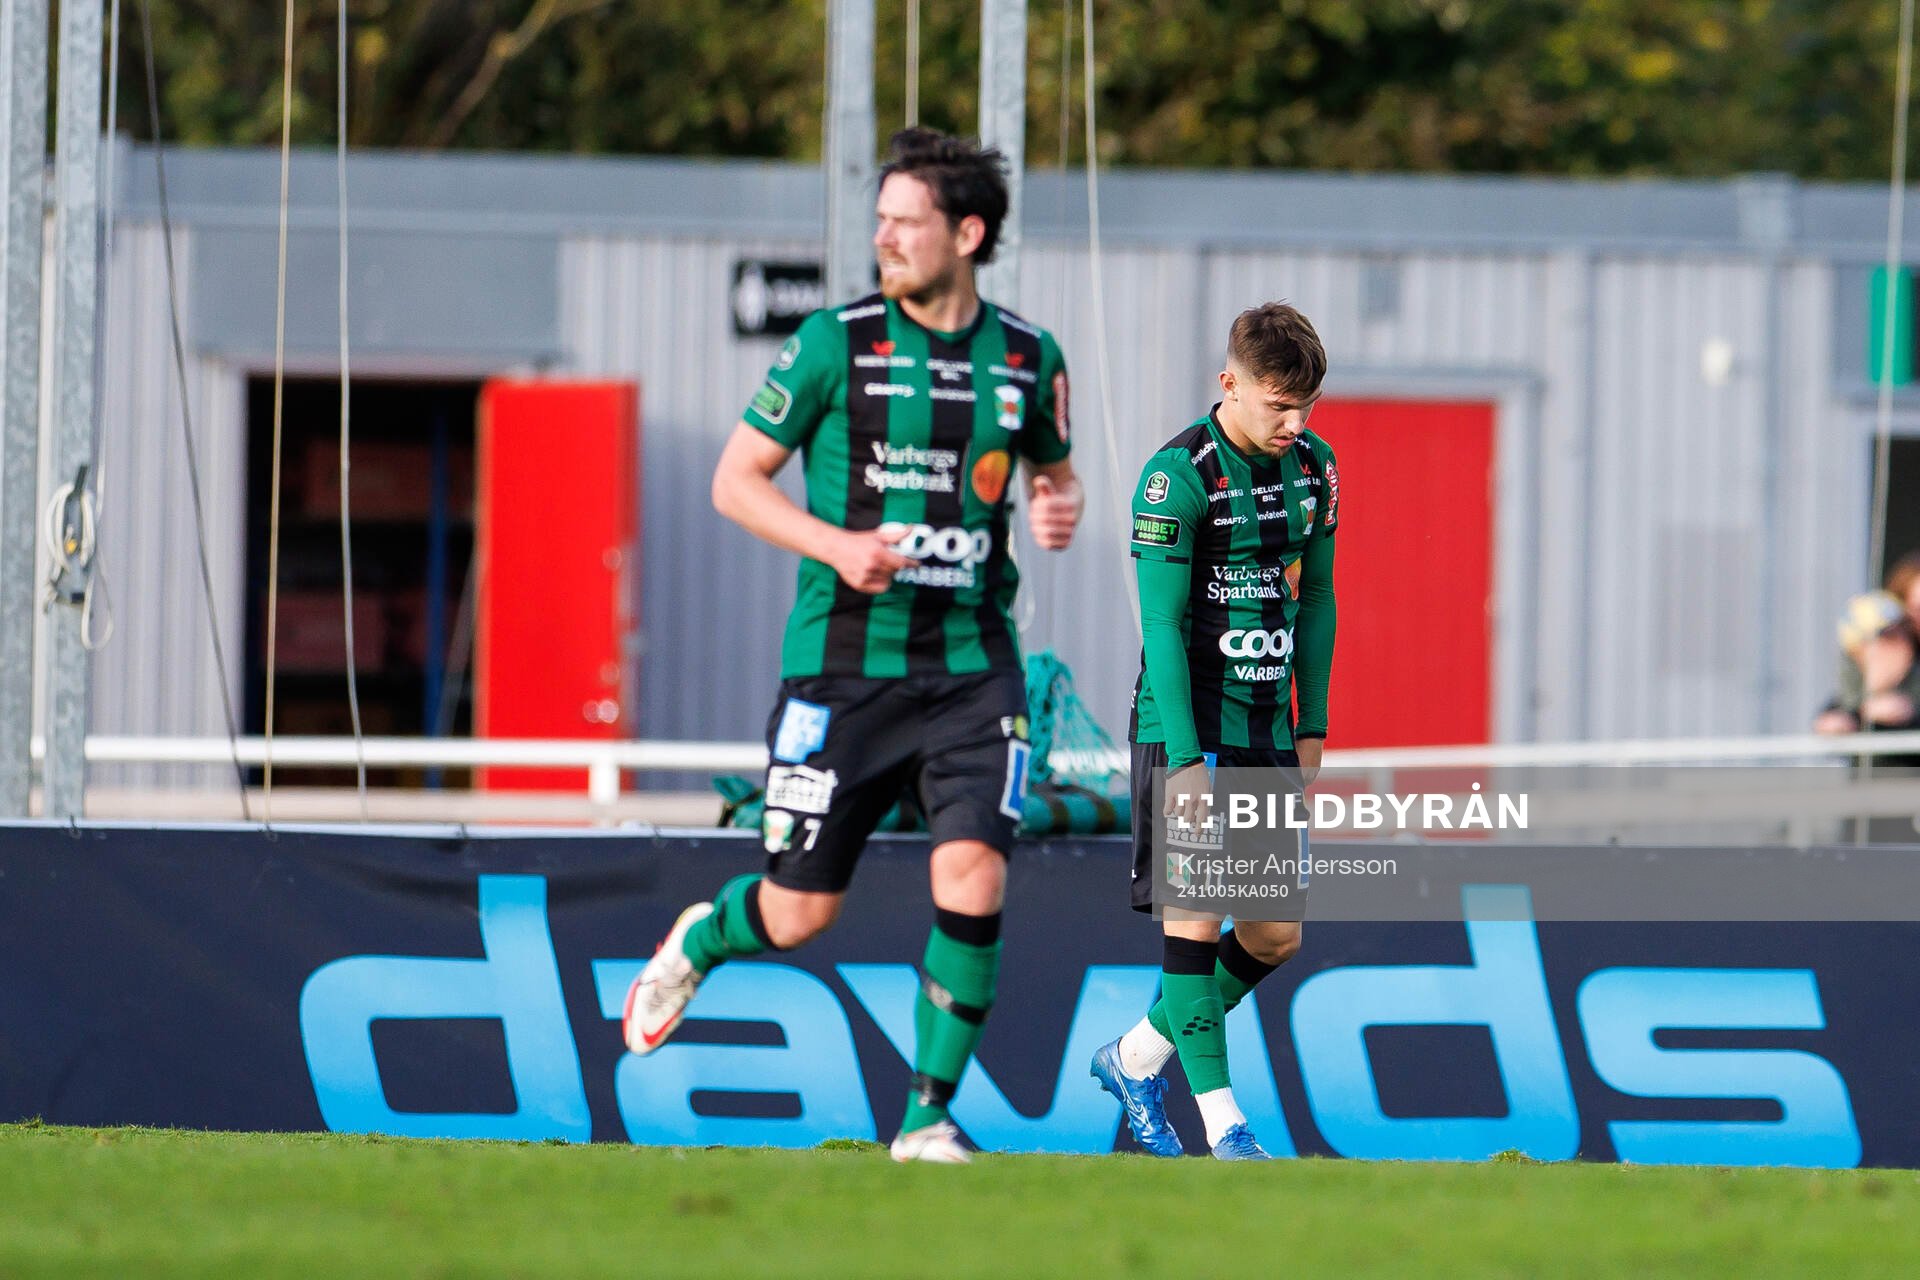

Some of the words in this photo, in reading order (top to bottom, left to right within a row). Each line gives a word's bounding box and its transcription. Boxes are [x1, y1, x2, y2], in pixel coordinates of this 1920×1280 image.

[871, 441, 959, 473] Varbergs
[864, 464, 956, 493] Sparbank
[1251, 484, 1285, 496] DELUXE
[1262, 494, 1277, 503] BIL
[1135, 520, 1177, 536] UNIBET
[1214, 517, 1242, 527] CRAFT
[1212, 566, 1280, 582] Varbergs
[1207, 581, 1281, 604] Sparbank
[803, 818, 822, 850] 7
